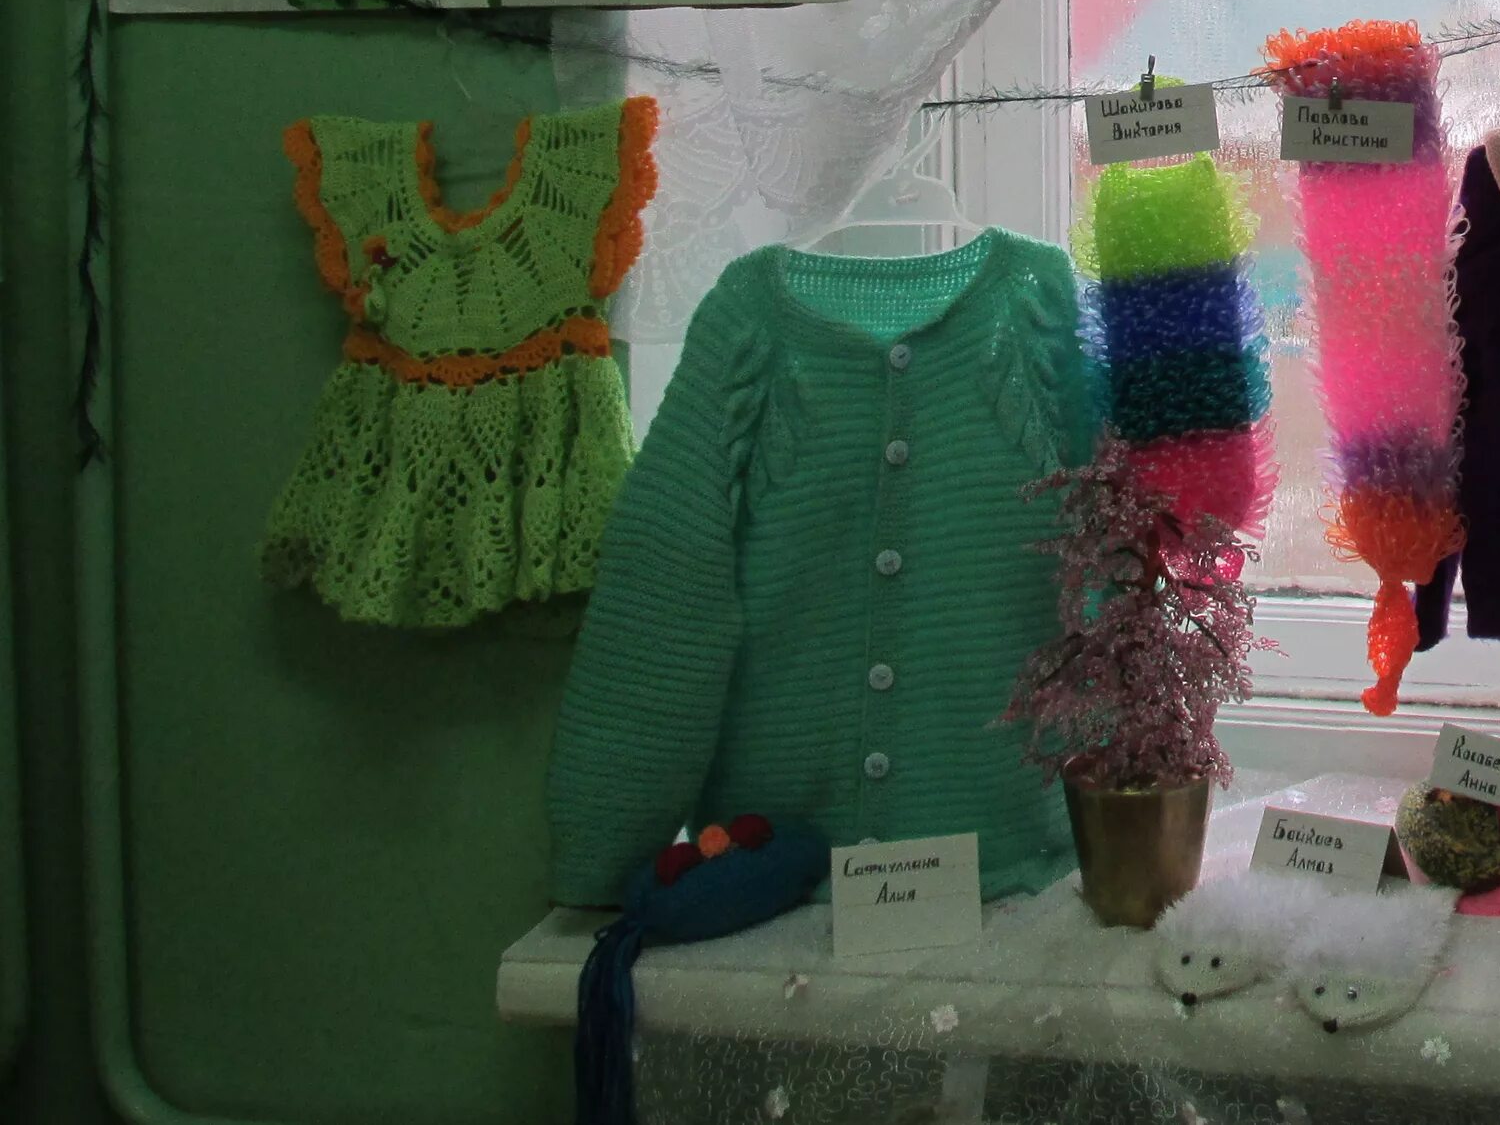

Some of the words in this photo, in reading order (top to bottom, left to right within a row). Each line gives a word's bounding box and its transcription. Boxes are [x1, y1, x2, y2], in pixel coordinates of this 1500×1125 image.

[1101, 97, 1184, 117] Шакирова
[1297, 105, 1369, 126] Павлова
[1113, 120, 1182, 141] Виктория
[1312, 127, 1389, 148] Кристина
[1458, 769, 1498, 796] Анна
[843, 857, 941, 878] Сафиуллина
[1286, 846, 1334, 874] Алмаз
[875, 881, 917, 906] Алия
